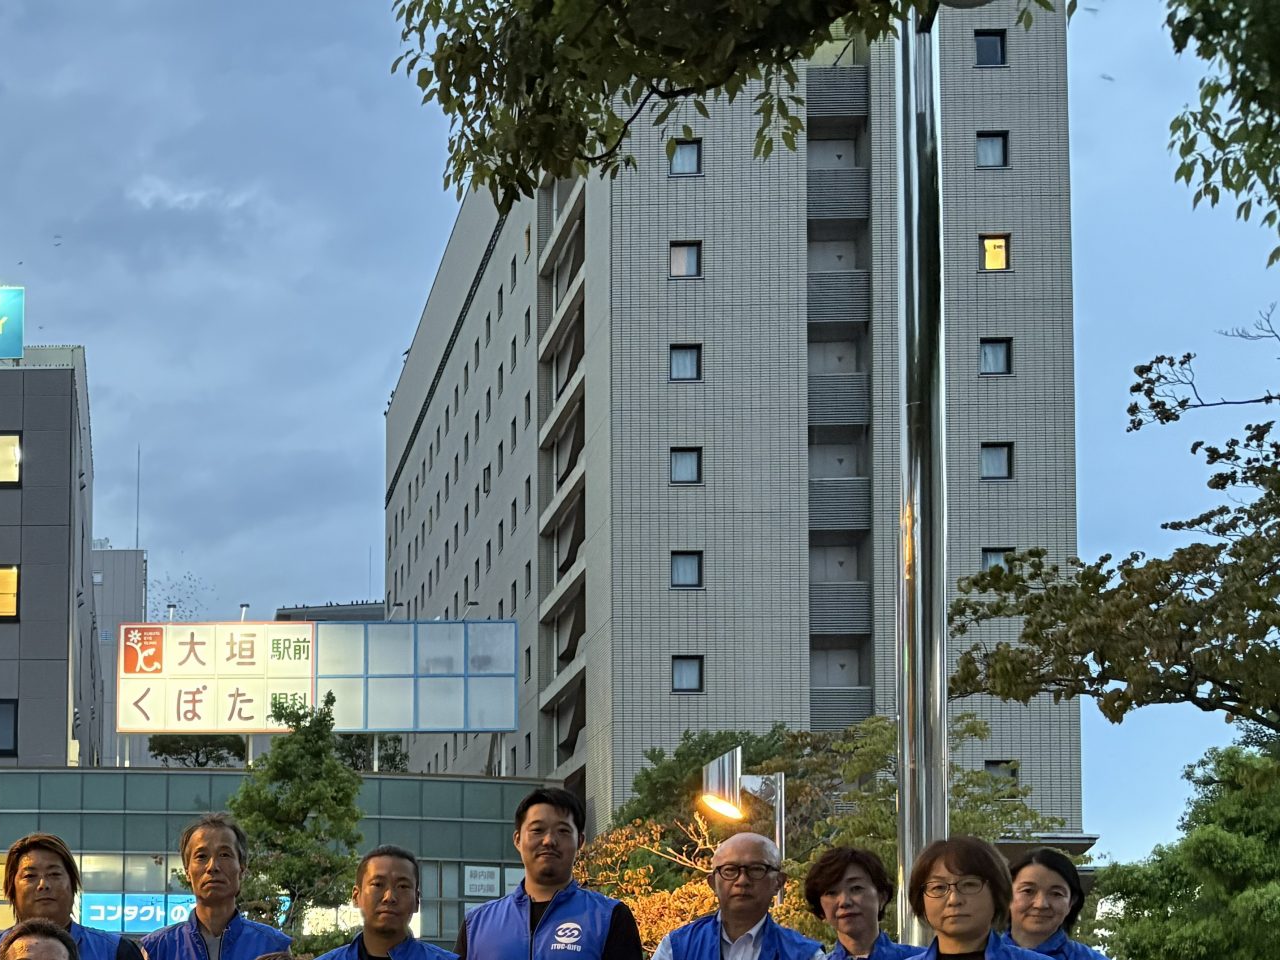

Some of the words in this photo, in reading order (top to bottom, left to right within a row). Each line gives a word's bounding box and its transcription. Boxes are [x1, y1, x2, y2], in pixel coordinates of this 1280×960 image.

[89, 903, 197, 922] コンタクトの
